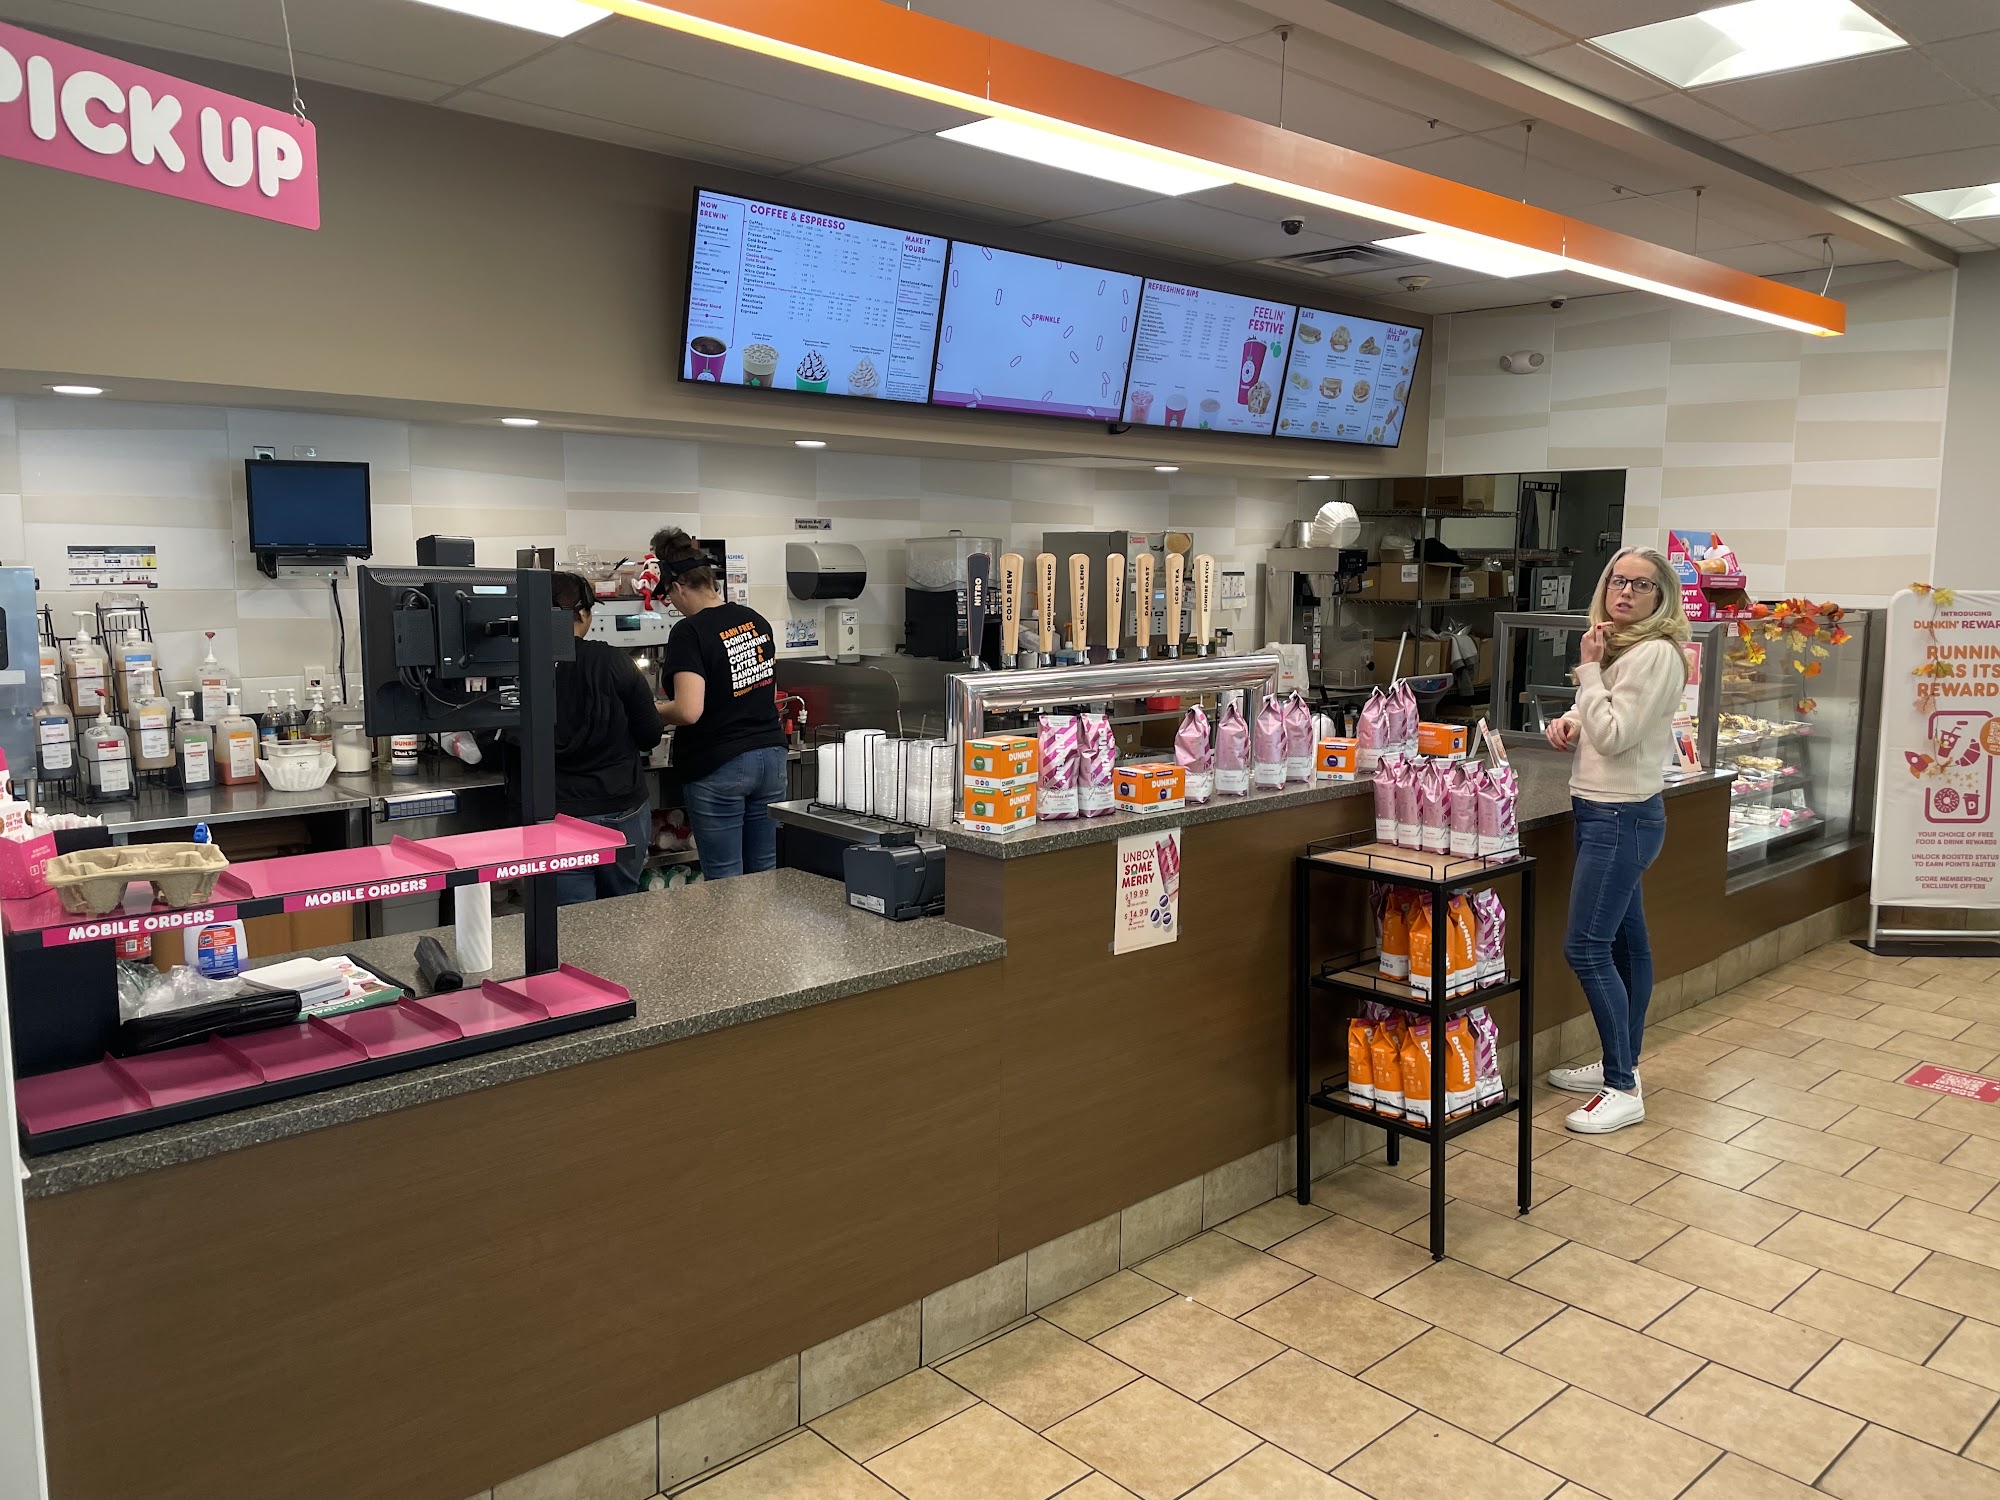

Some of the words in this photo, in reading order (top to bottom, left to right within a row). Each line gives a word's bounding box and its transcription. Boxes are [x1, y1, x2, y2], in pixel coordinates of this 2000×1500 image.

[200, 106, 303, 197] UP
[700, 201, 718, 209] NOW
[700, 209, 728, 220] BREWIN'
[750, 204, 788, 219] COFFEE
[790, 212, 797, 221] &
[799, 214, 845, 230] ESPRESSO
[905, 235, 923, 244] MAKE
[904, 244, 926, 254] YOURS
[1148, 282, 1185, 295] REFRESHING
[1186, 290, 1199, 298] SIPS
[1032, 314, 1061, 324] SPRINKLE
[1254, 306, 1286, 321] FEELIN'
[1302, 311, 1315, 319] EATS
[1248, 319, 1285, 334] FESTIVE
[1388, 327, 1409, 336] ALL-DAY
[1387, 334, 1401, 342] BITES
[974, 578, 982, 606] NITRO
[720, 627, 739, 640] EARN
[738, 622, 755, 633] FREE
[1914, 620, 1959, 629] DUNKIN'
[723, 631, 752, 648] DONUTS
[729, 648, 757, 665] COFFEE
[1927, 645, 2000, 660] RUNNIN
[731, 657, 757, 673] LATTES
[1973, 664, 2000, 678] ITS
[1917, 682, 2000, 697] REWARD
[1008, 750, 1033, 762] DUNKIN'
[1151, 777, 1179, 788] DUNKIN'
[1010, 793, 1032, 807] DUNKIN'
[6, 813, 15, 821] GET
[14, 818, 24, 826] THE
[1124, 849, 1155, 863] UNBOX
[496, 860, 547, 879] MOBILE
[550, 853, 600, 871] ORDERS
[1124, 861, 1153, 876] SOME
[1122, 873, 1155, 889] MERRY
[304, 889, 365, 908] MOBILE
[368, 879, 428, 898] ORDERS
[68, 919, 140, 941] MOBILE
[144, 910, 215, 930] ORDERS
[1480, 1025, 1498, 1071] DUNKIN'
[1452, 1036, 1471, 1085] DUNKIN'
